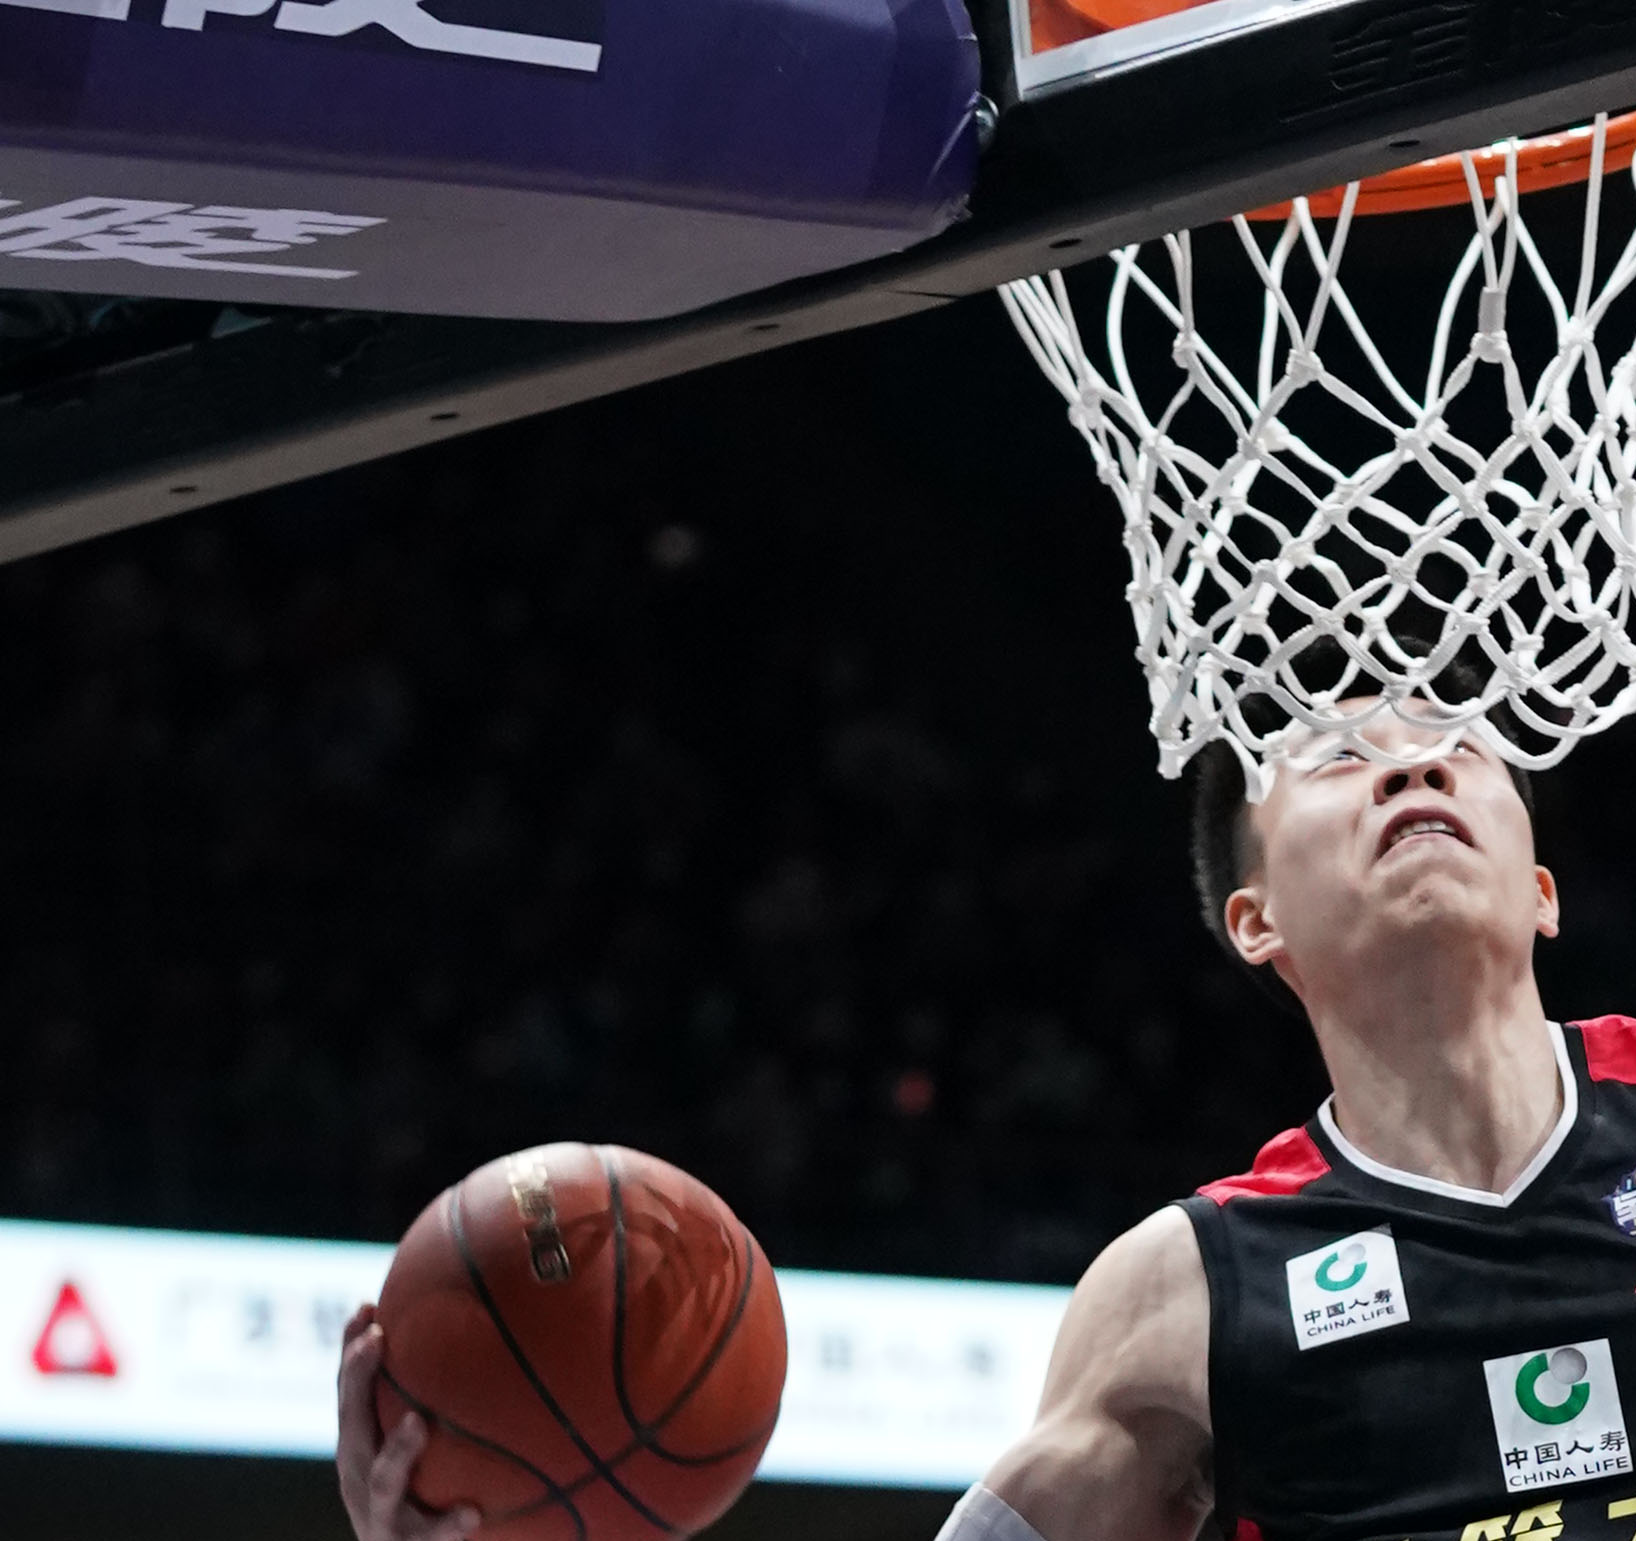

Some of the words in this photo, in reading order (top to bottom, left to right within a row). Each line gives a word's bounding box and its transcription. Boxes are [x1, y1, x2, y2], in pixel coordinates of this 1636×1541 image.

[1304, 1289, 1392, 1324] 中国人寿
[1307, 1317, 1356, 1337] CHINA
[1362, 1305, 1396, 1322] LIFE
[1504, 1430, 1626, 1470] 中国人寿
[1509, 1467, 1576, 1487] CHINA
[1584, 1456, 1630, 1475] LIFE
